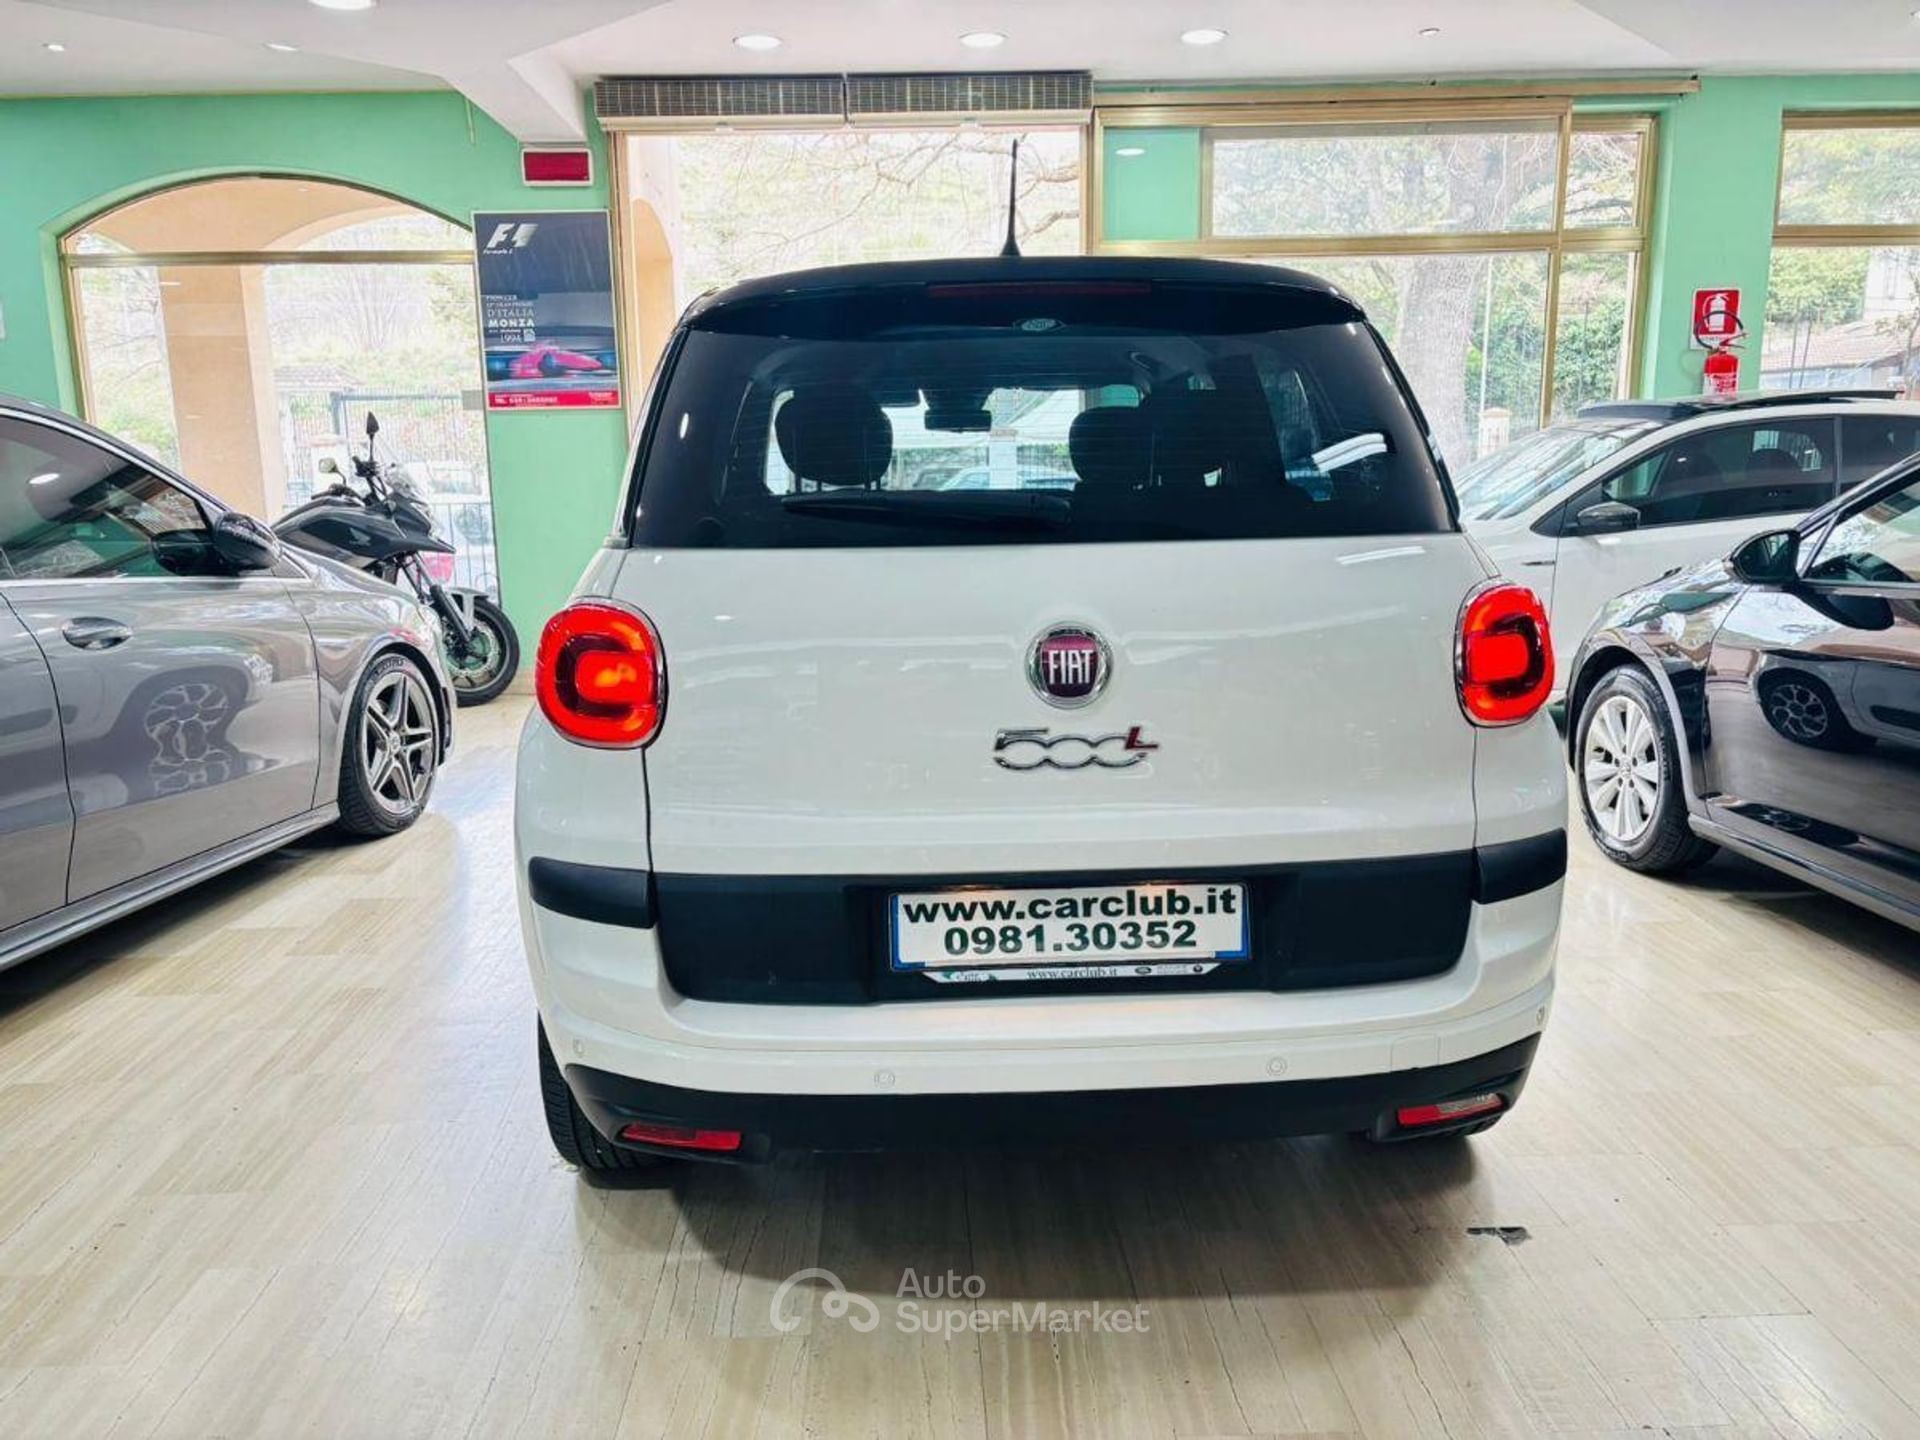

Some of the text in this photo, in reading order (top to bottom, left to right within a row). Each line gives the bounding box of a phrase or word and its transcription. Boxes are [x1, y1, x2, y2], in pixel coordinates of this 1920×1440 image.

[488, 319, 535, 328] MONZA
[1049, 650, 1093, 684] FIAT
[903, 888, 1236, 923] www.carclub.it
[944, 920, 1197, 955] 0981.30352
[1026, 966, 1118, 980] www.carclub.it
